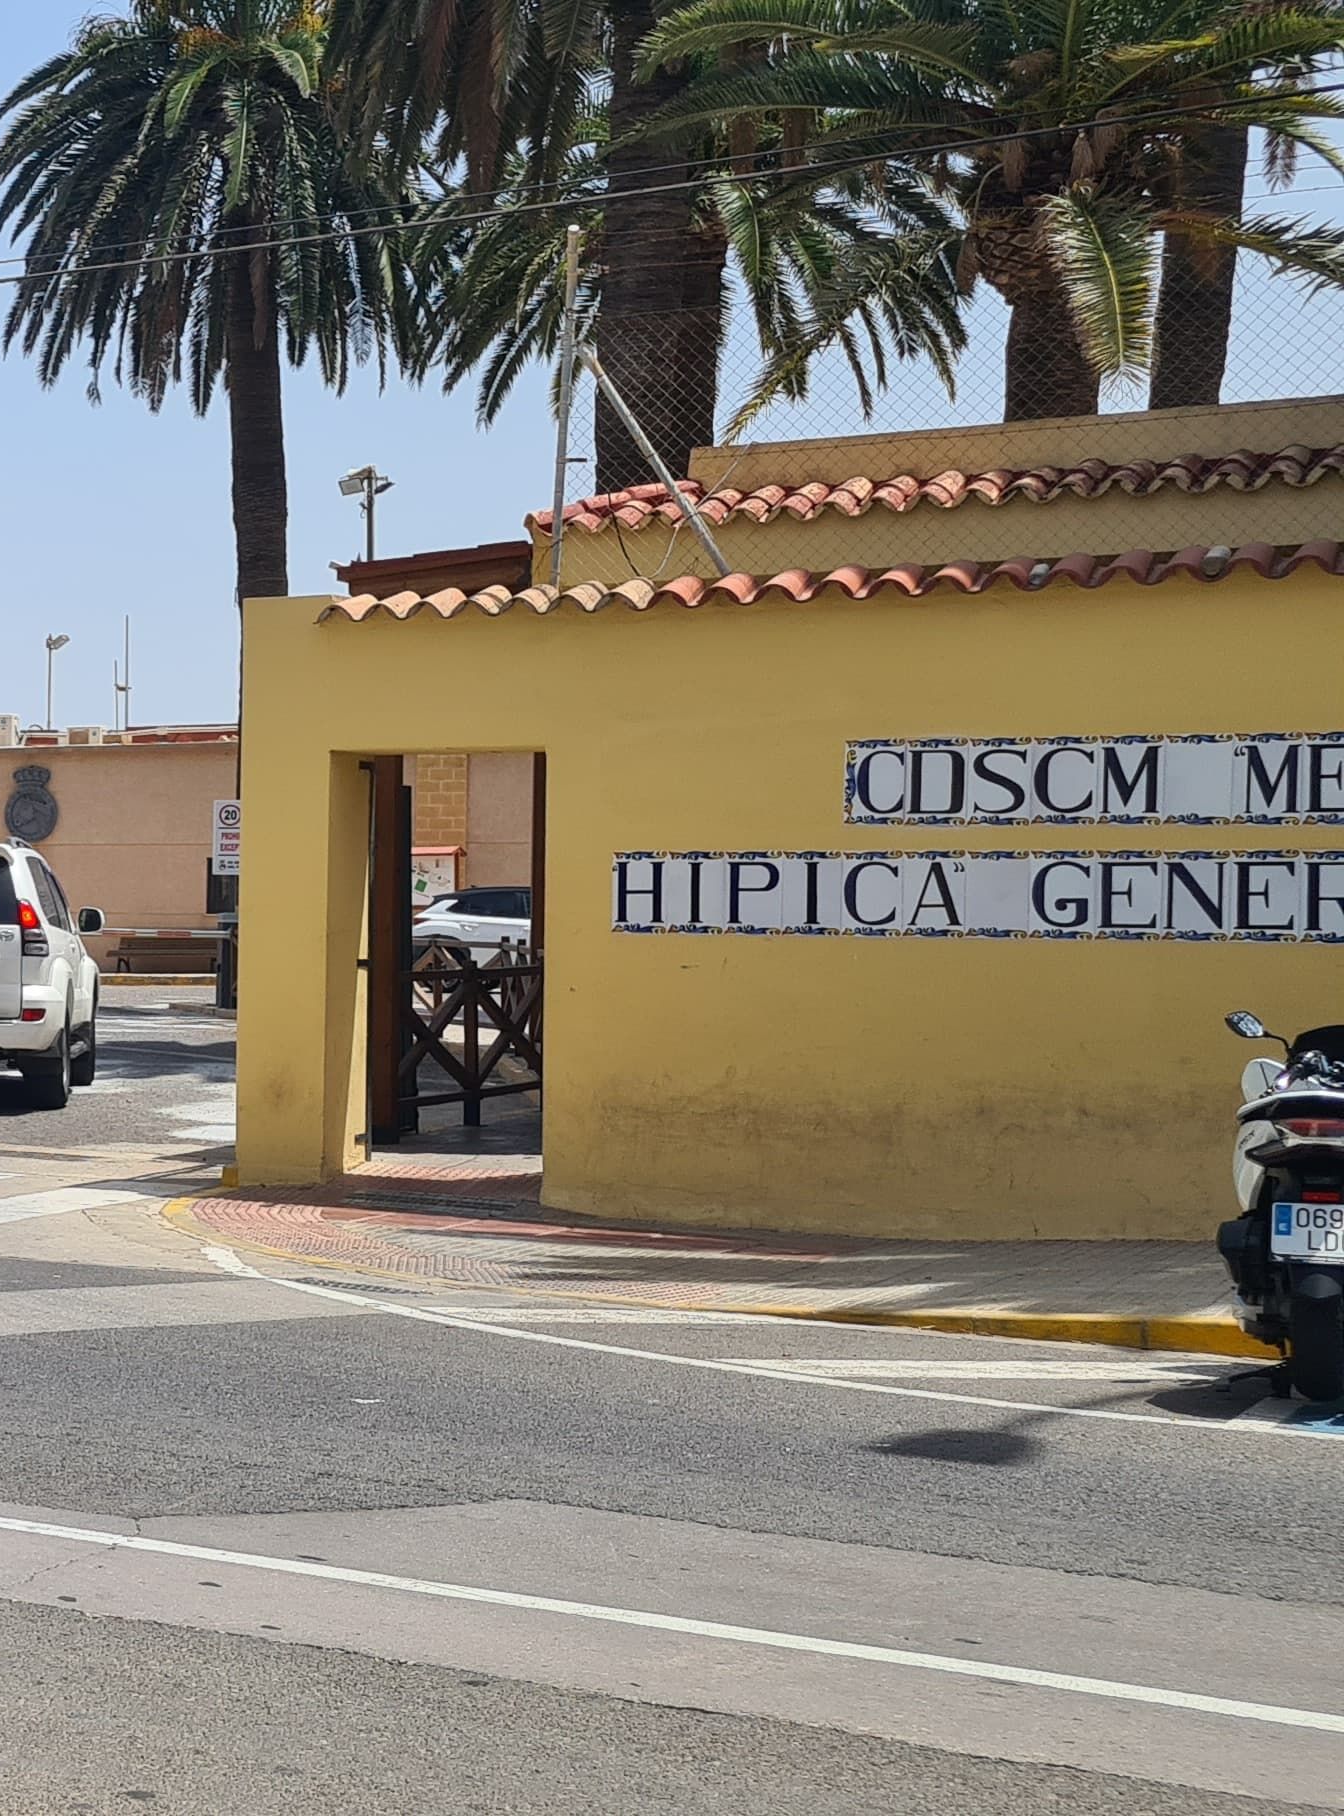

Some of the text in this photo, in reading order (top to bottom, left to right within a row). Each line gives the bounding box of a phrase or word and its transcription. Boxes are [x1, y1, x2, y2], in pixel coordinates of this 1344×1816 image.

[856, 744, 1163, 816] CDSCM
[223, 809, 238, 821] 20
[1307, 1230, 1344, 1252] LD
